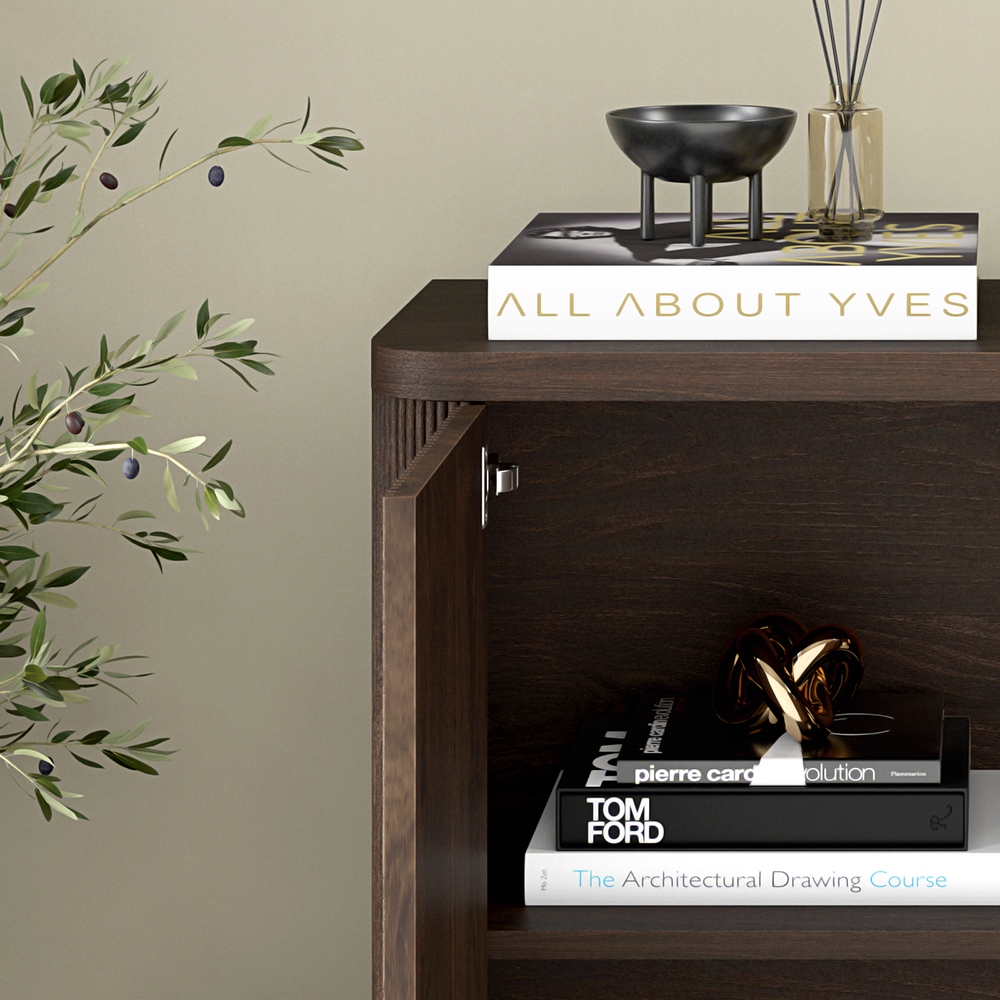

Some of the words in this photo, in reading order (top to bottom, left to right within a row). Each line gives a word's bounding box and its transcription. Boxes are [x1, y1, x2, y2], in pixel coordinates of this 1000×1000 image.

[876, 223, 964, 262] YVES
[496, 292, 591, 318] ALL
[615, 292, 801, 318] ABOUT
[828, 292, 970, 318] YVES
[635, 765, 702, 784] pierre
[706, 765, 760, 782] card
[586, 797, 650, 821] TOM
[586, 821, 665, 844] FORD
[573, 869, 615, 888] The
[621, 869, 762, 888] Architectural
[771, 869, 862, 894] Drawing
[869, 870, 947, 888] Course
